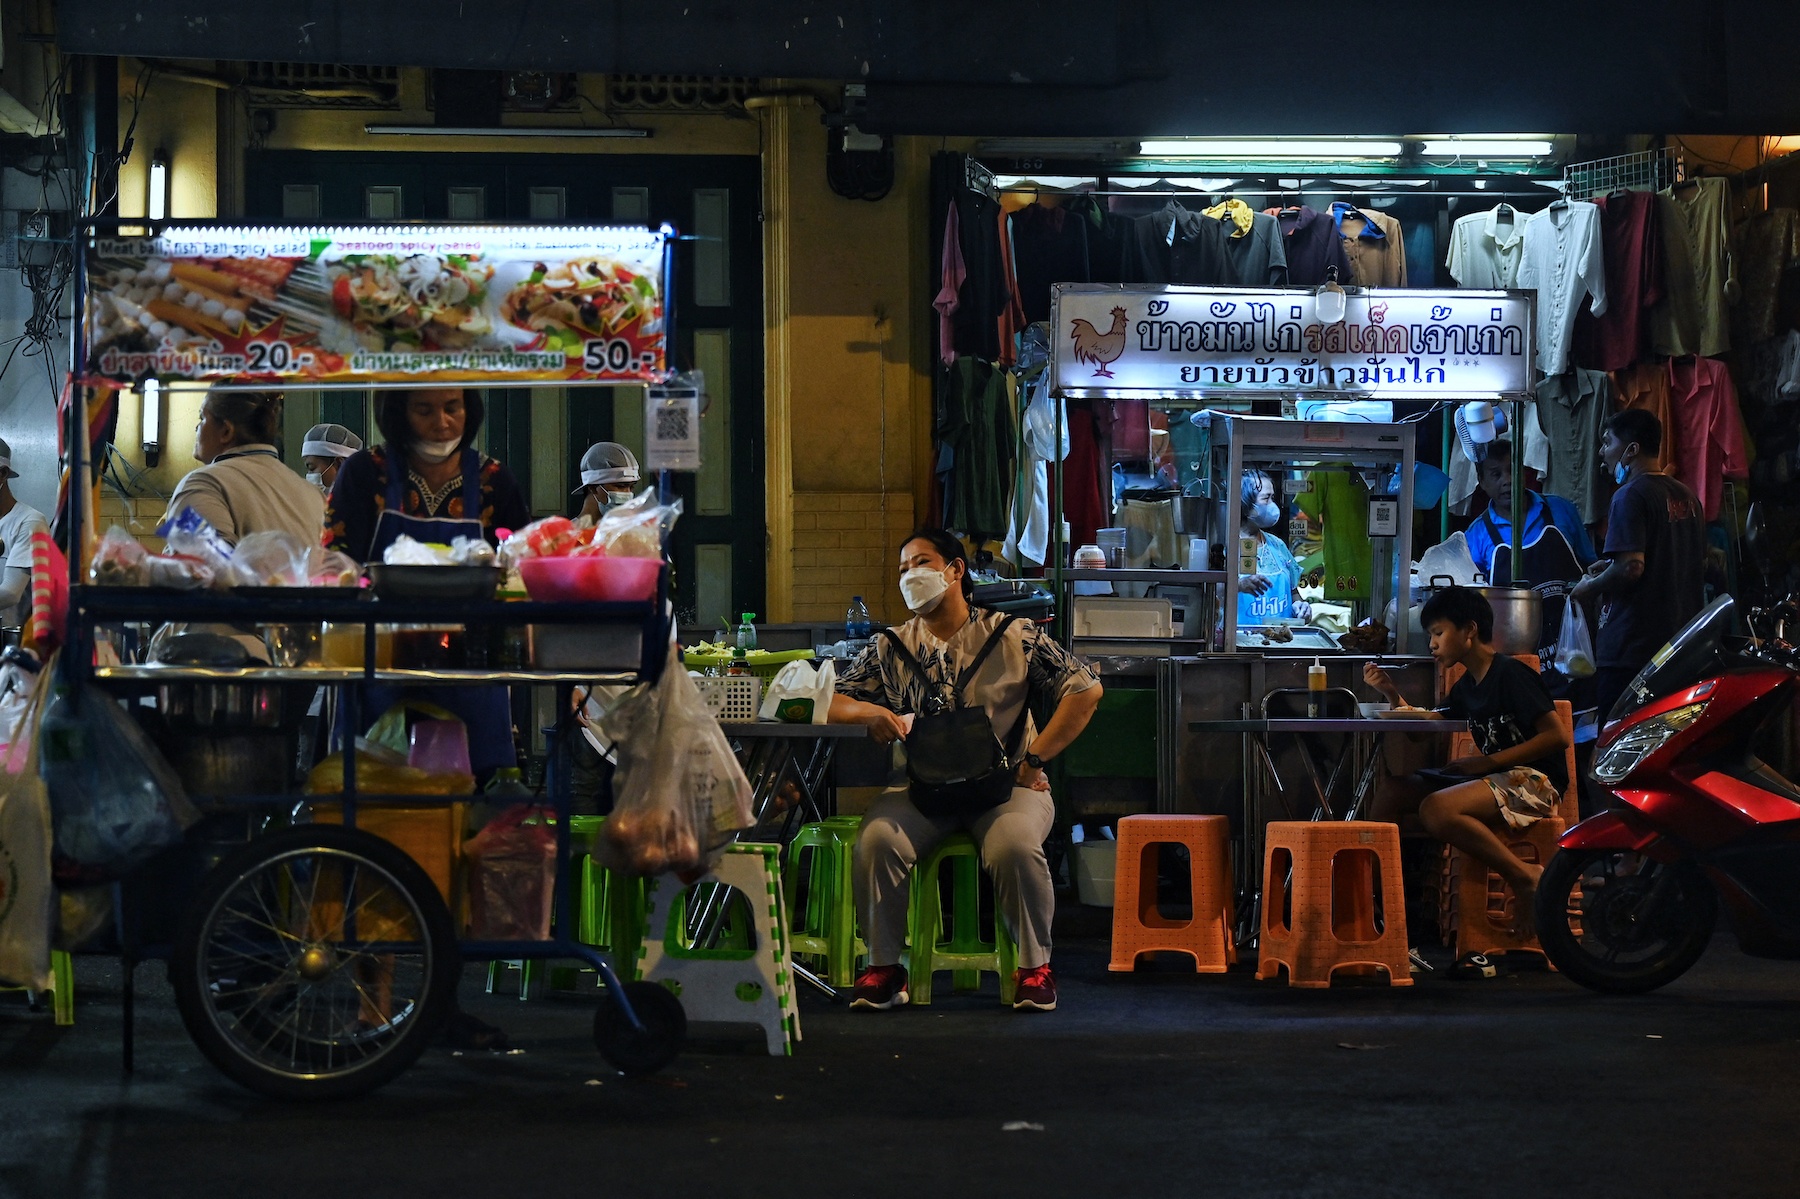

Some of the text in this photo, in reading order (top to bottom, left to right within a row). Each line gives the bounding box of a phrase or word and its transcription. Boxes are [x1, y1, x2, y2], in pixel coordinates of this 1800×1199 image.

[174, 241, 198, 255] fish
[203, 241, 228, 255] ball
[233, 242, 267, 258] spicy
[273, 241, 307, 255] salad
